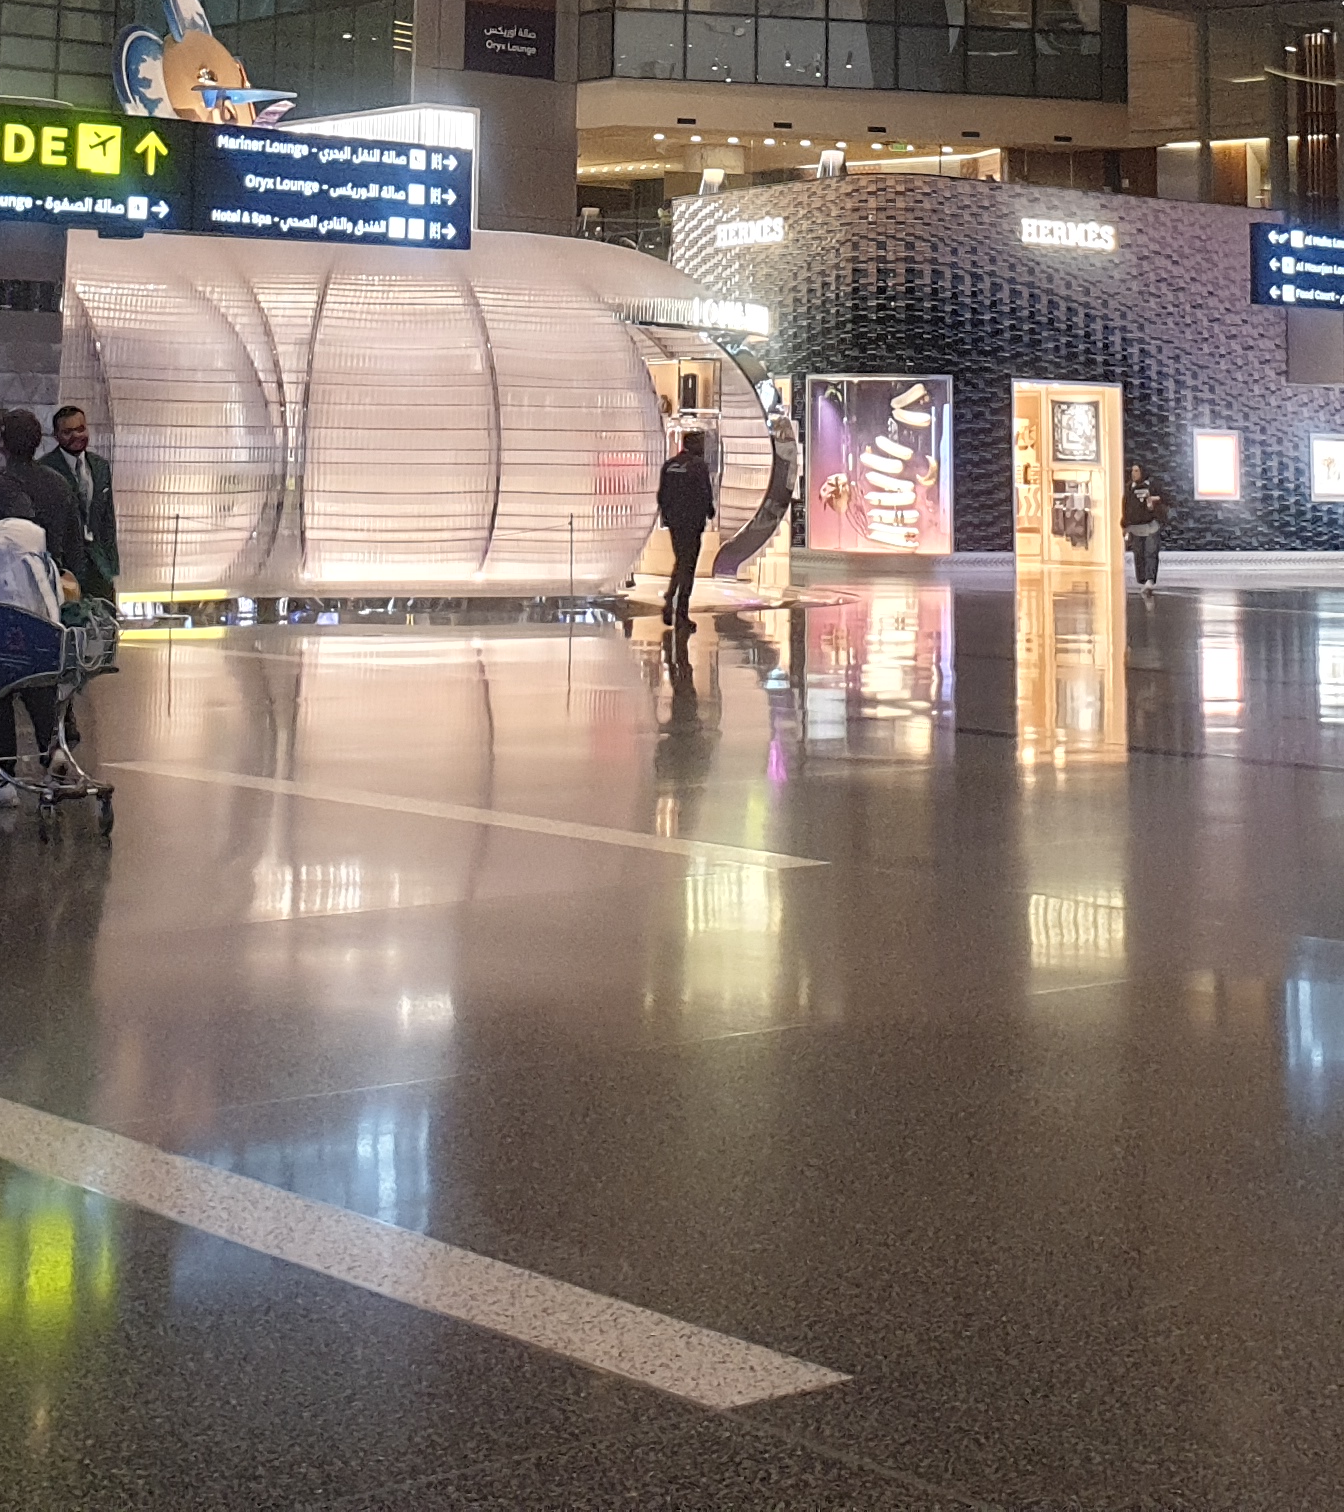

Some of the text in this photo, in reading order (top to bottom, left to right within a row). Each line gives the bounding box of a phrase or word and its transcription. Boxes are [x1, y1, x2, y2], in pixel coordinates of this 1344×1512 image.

[485, 39, 537, 56] Oryx Lounge
[217, 134, 265, 152] Mariner
[265, 138, 309, 158] Lounge
[318, 145, 407, 165] صالة النقل البحري
[245, 173, 275, 192] Oryx
[275, 176, 320, 196] Lounge
[380, 183, 406, 201] صالة
[44, 195, 125, 215] صالة الصفوة
[212, 208, 241, 224] Hotel
[251, 211, 272, 228] Spa
